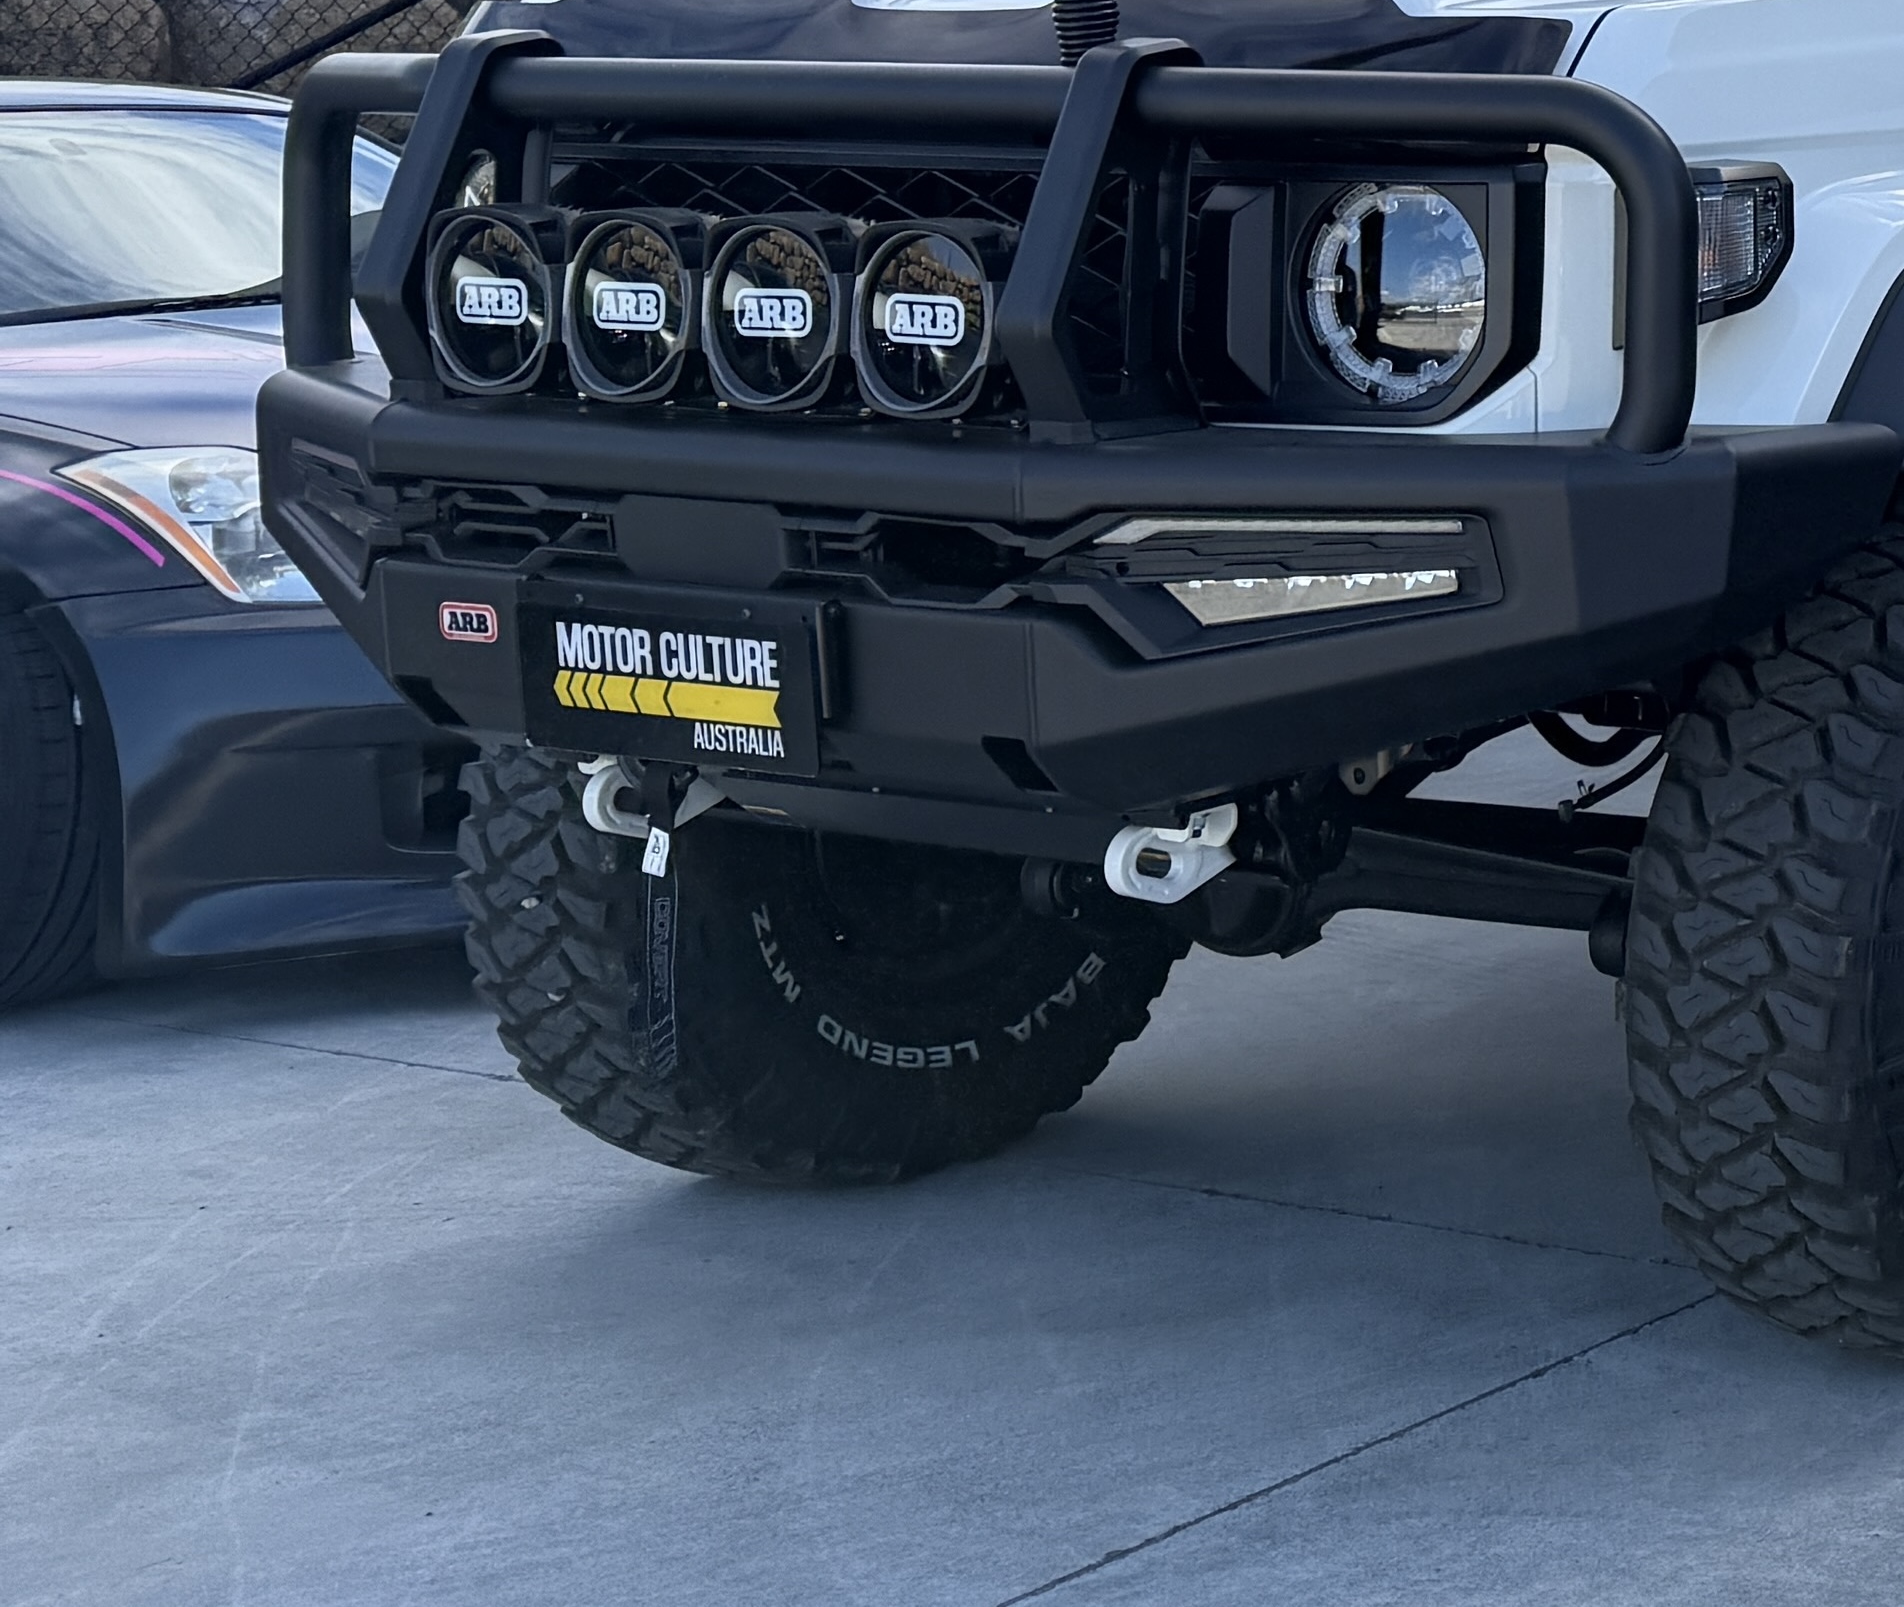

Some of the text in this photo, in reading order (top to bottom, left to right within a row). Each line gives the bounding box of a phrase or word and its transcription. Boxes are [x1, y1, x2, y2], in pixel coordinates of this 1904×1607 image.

[463, 283, 522, 318] ARB
[599, 289, 659, 324] ARB
[741, 295, 805, 331] ARB
[892, 302, 959, 338] ARB
[555, 620, 781, 689] MOTOR CULTURE
[693, 721, 786, 759] AUSTRALIA
[1003, 951, 1108, 1043] BAJA
[816, 1013, 981, 1069] LEGEND
